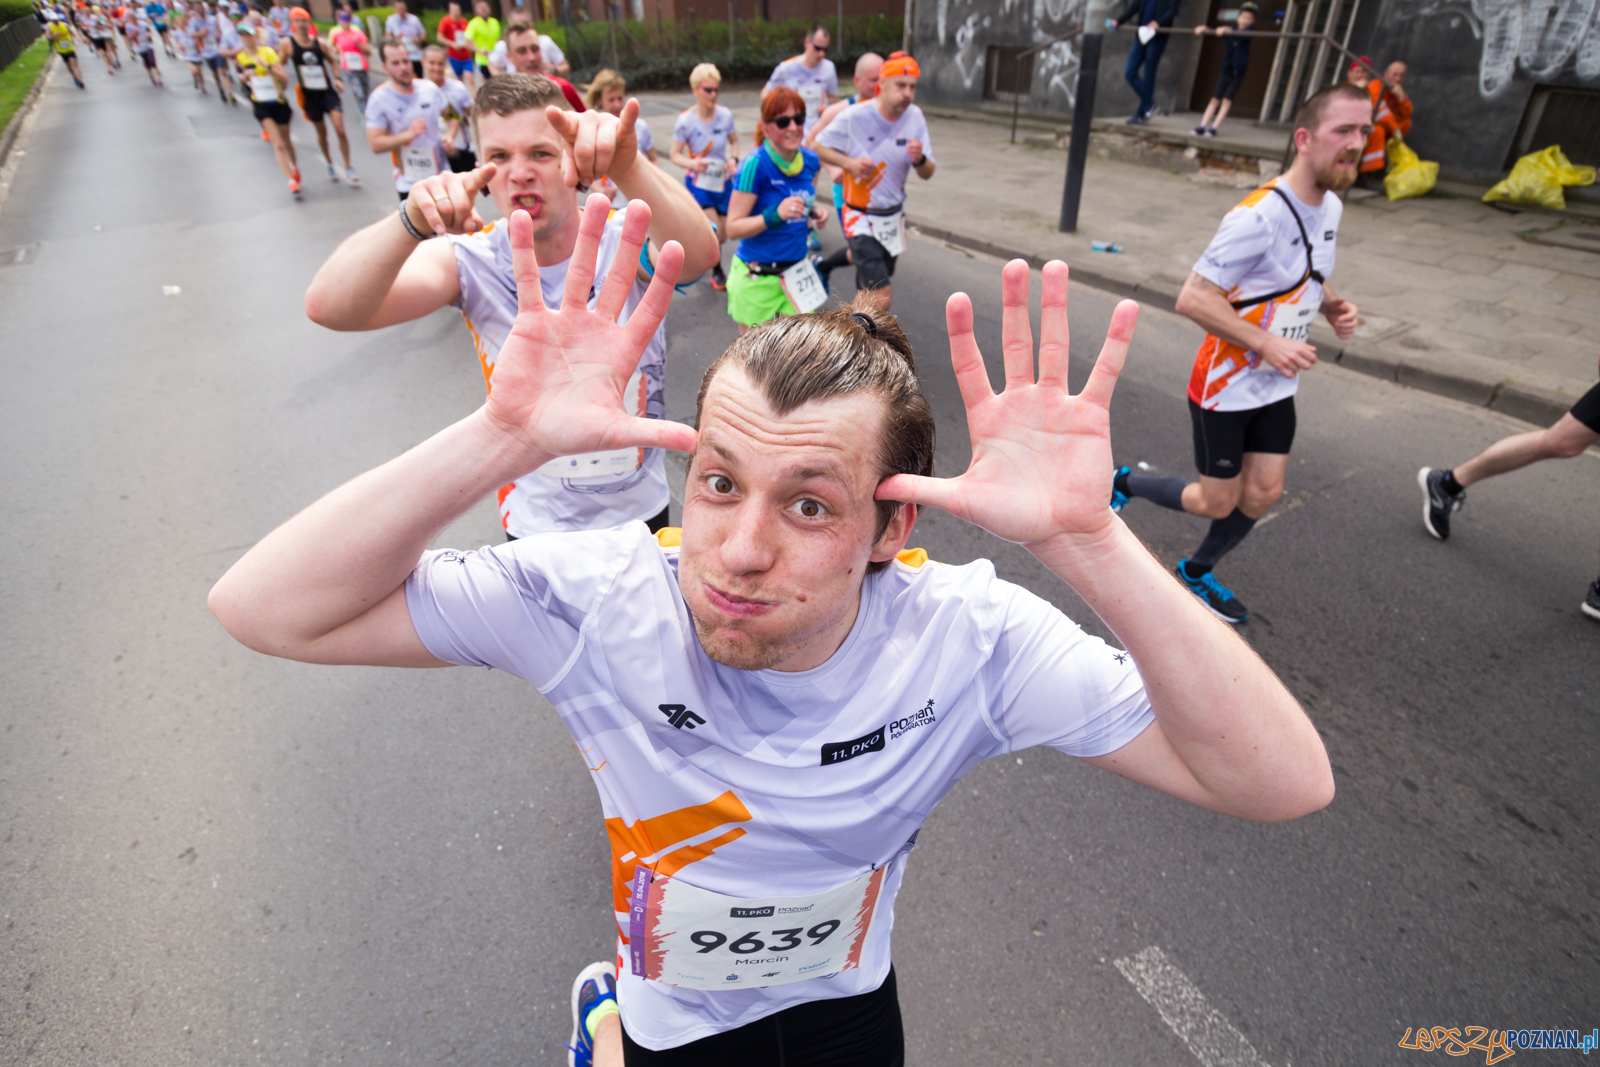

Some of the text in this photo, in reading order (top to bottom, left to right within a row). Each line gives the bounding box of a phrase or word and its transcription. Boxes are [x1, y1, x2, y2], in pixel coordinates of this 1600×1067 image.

[658, 704, 707, 729] 4F
[831, 734, 880, 761] 11. PKO
[736, 908, 748, 916] 11.
[749, 908, 771, 916] PKO
[690, 919, 841, 954] 9639
[735, 956, 789, 966] Marcin
